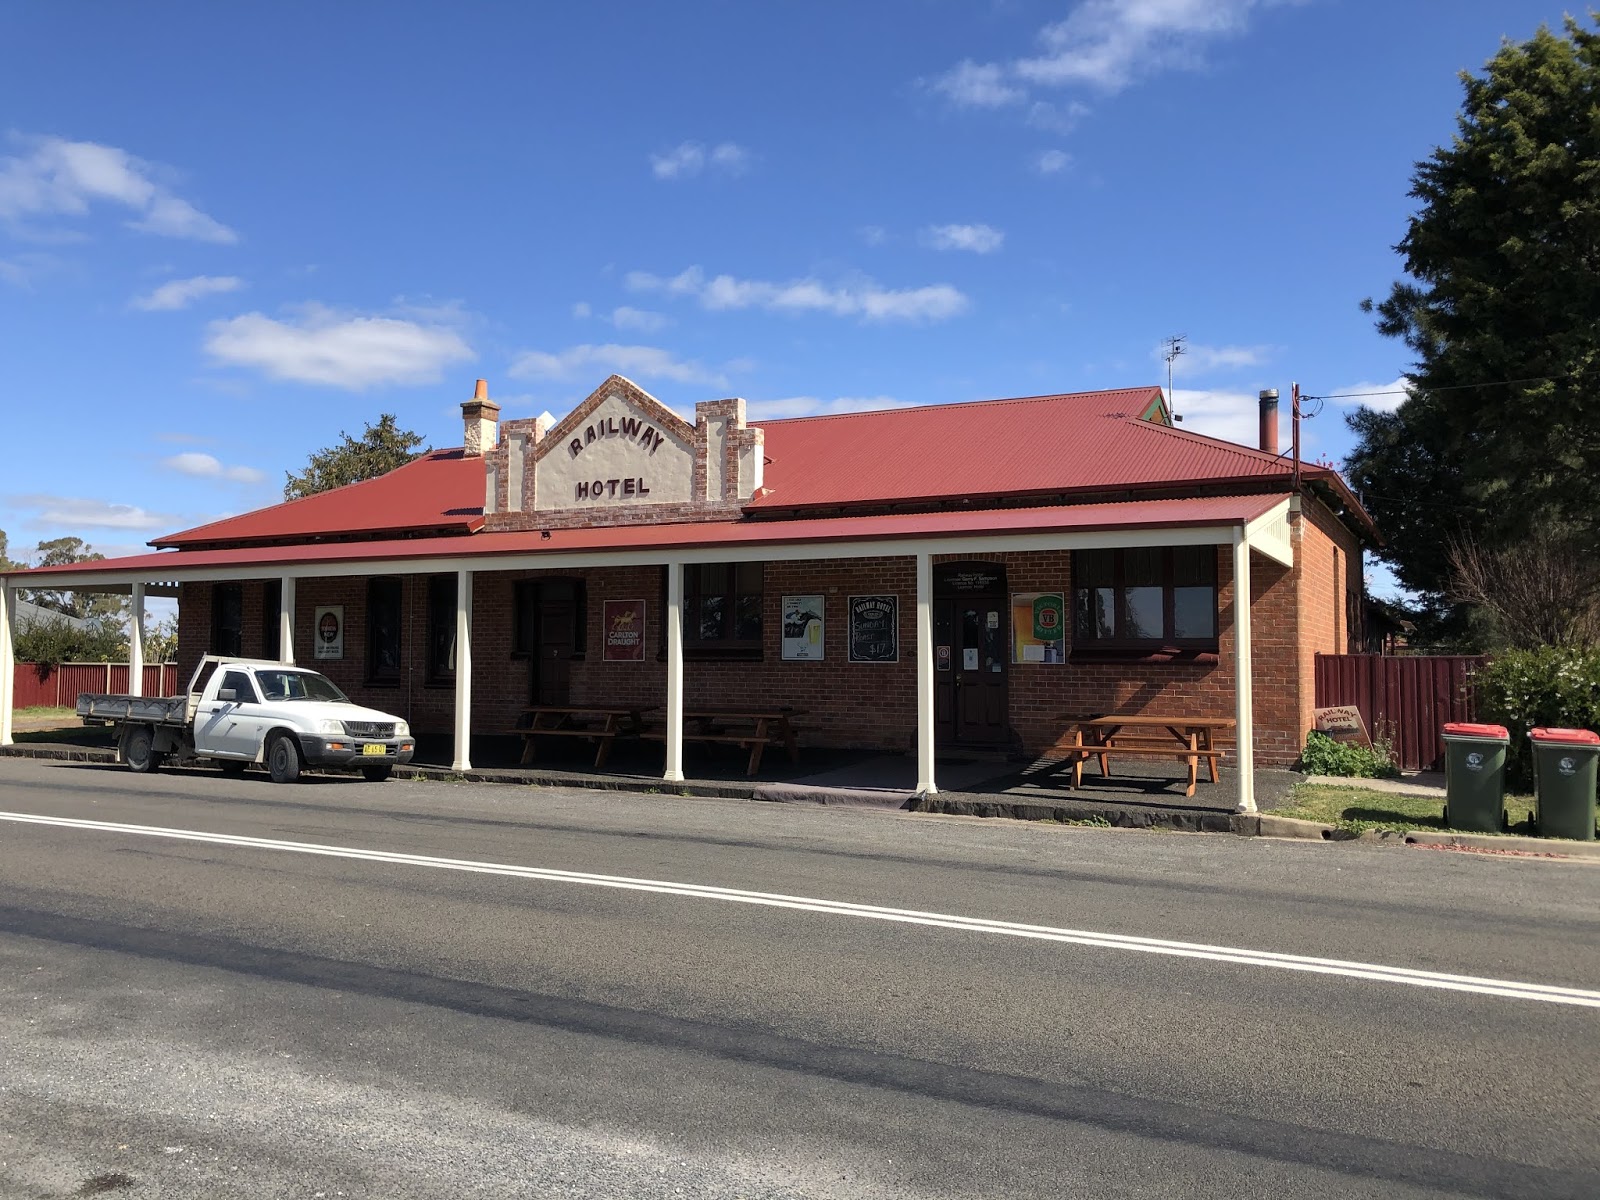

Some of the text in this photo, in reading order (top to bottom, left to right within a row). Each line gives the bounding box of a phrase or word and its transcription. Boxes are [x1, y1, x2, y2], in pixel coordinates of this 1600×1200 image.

[568, 416, 665, 460] RAILWAY
[575, 477, 650, 501] HOTEL
[1042, 614, 1055, 623] VB
[609, 631, 639, 639] CARLTON
[607, 638, 640, 646] DRAUGHT
[869, 643, 886, 655] $17
[1326, 716, 1353, 724] HOTEL
